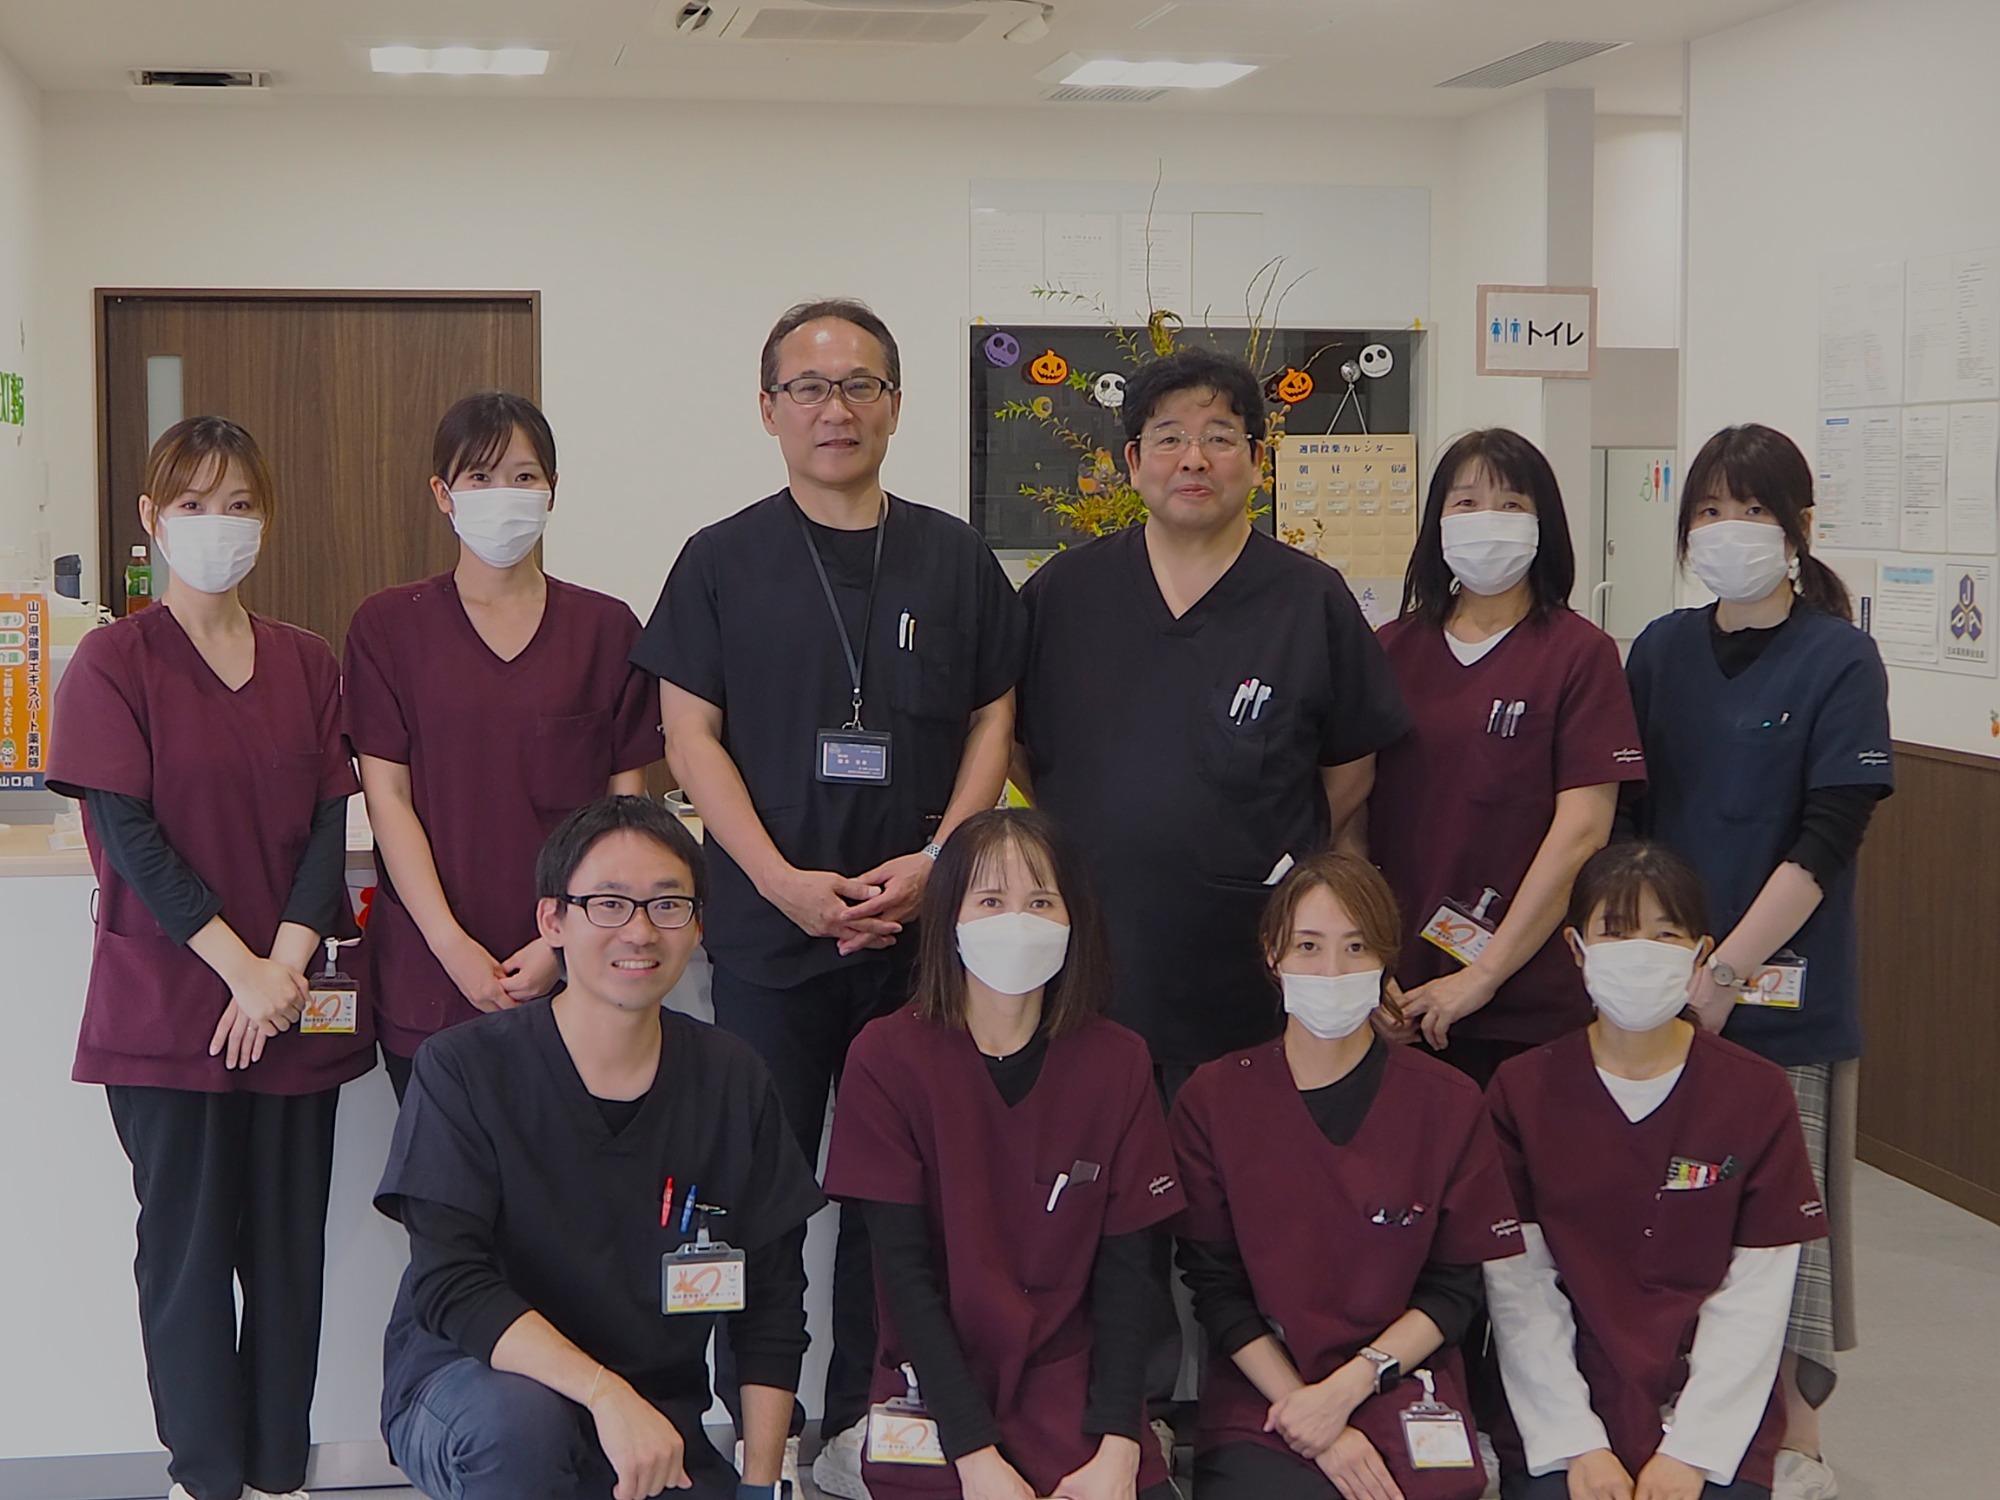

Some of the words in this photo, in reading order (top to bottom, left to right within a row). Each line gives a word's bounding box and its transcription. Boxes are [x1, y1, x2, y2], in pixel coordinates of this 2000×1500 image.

[1528, 320, 1584, 346] トイレ
[3, 668, 14, 736] ご相談ください
[28, 601, 40, 769] 山口県健康エキスパート薬剤師
[0, 775, 34, 788] 山口県
